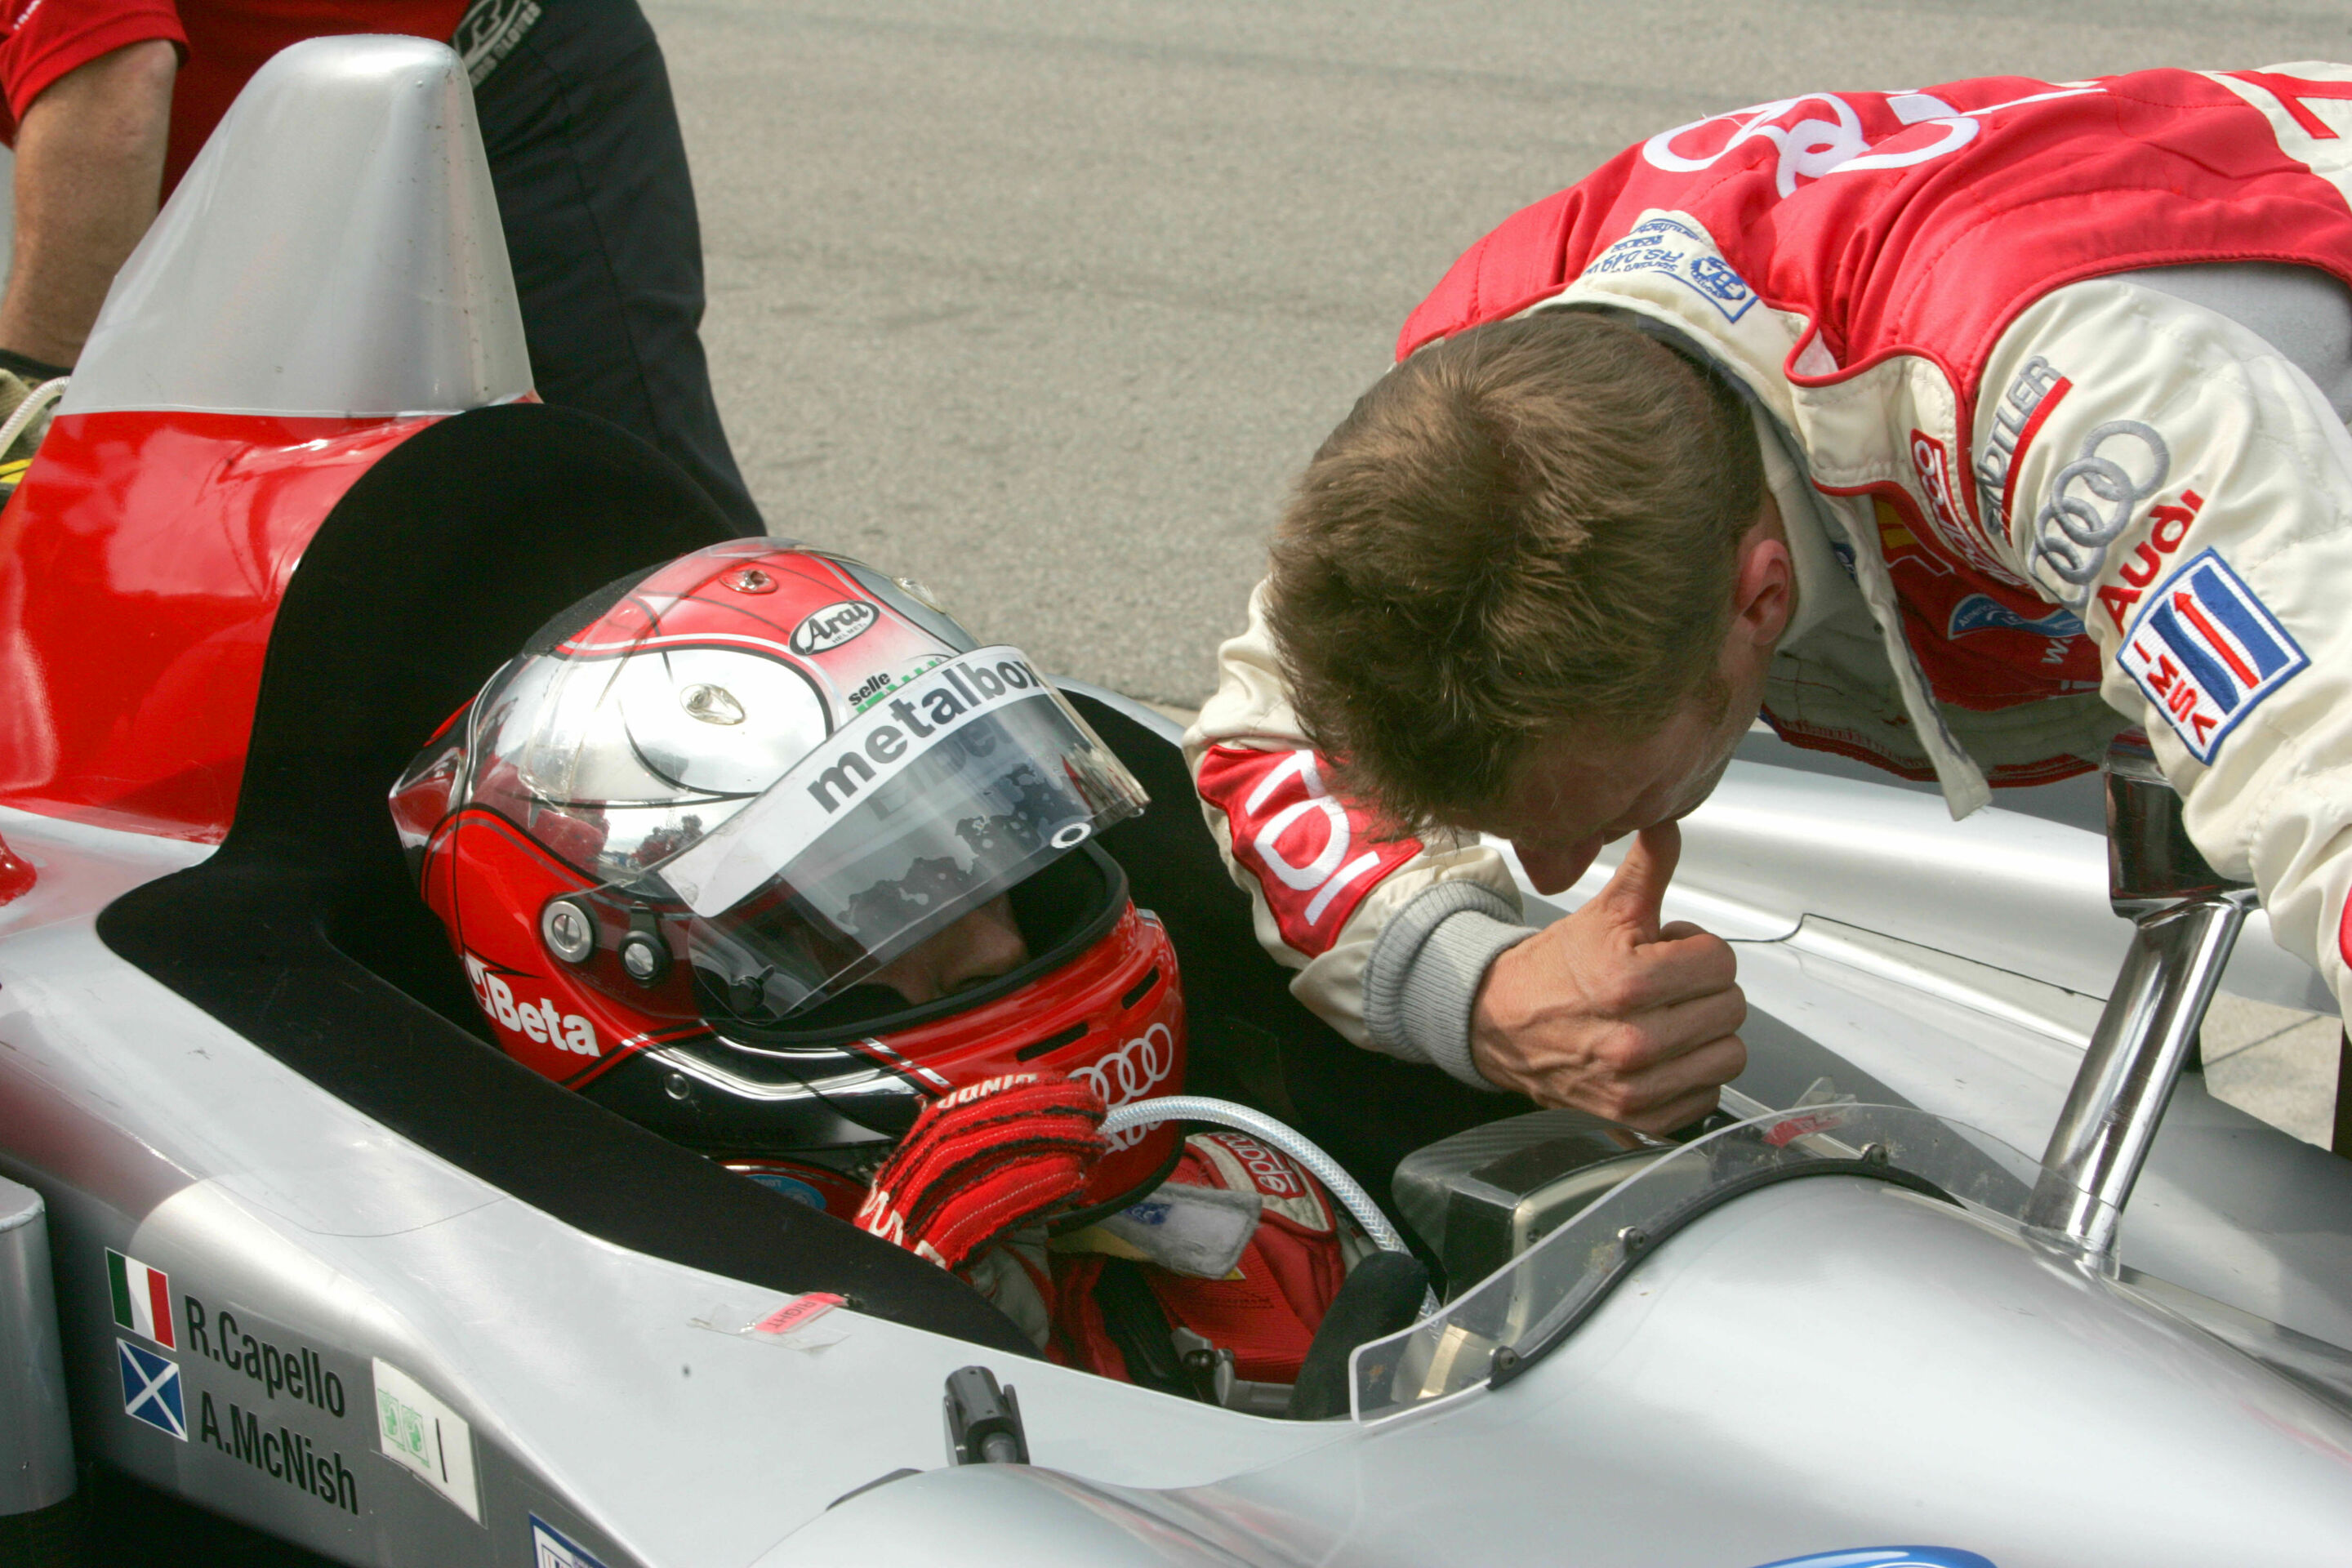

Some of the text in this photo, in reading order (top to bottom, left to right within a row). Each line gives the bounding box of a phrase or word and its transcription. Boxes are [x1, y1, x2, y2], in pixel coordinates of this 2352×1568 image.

[804, 601, 869, 655] Arai
[849, 671, 891, 706] selle
[486, 972, 602, 1058] Beta
[185, 1294, 345, 1418] R.Capello
[201, 1390, 359, 1517] A.McNish
